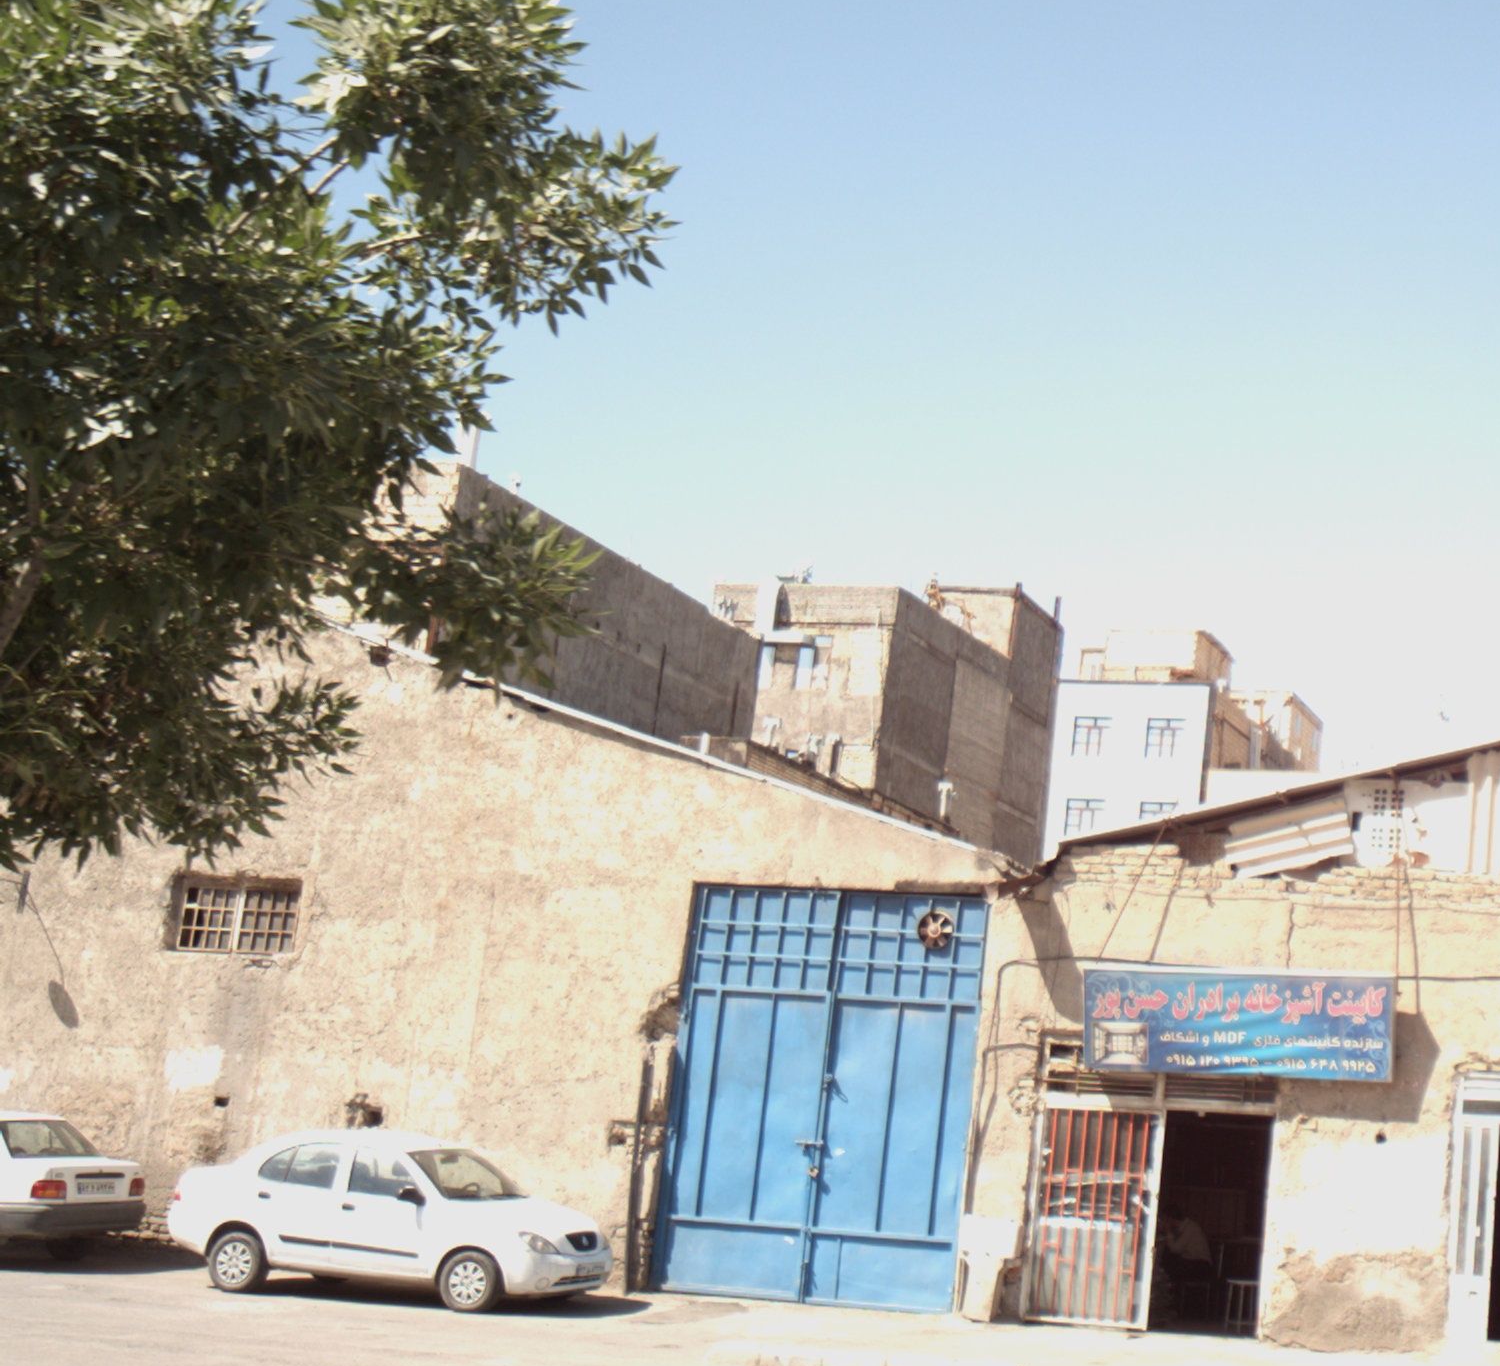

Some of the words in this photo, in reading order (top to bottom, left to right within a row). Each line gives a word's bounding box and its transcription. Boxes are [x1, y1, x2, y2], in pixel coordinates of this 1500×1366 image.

[1092, 988, 1121, 1020] پور
[1124, 989, 1169, 1020] حسن
[1172, 981, 1241, 1023] برادران
[1327, 986, 1387, 1025] کابینت
[1202, 1035, 1210, 1047] و
[1213, 1031, 1247, 1044] MDF
[1343, 1036, 1384, 1052] سازنده
